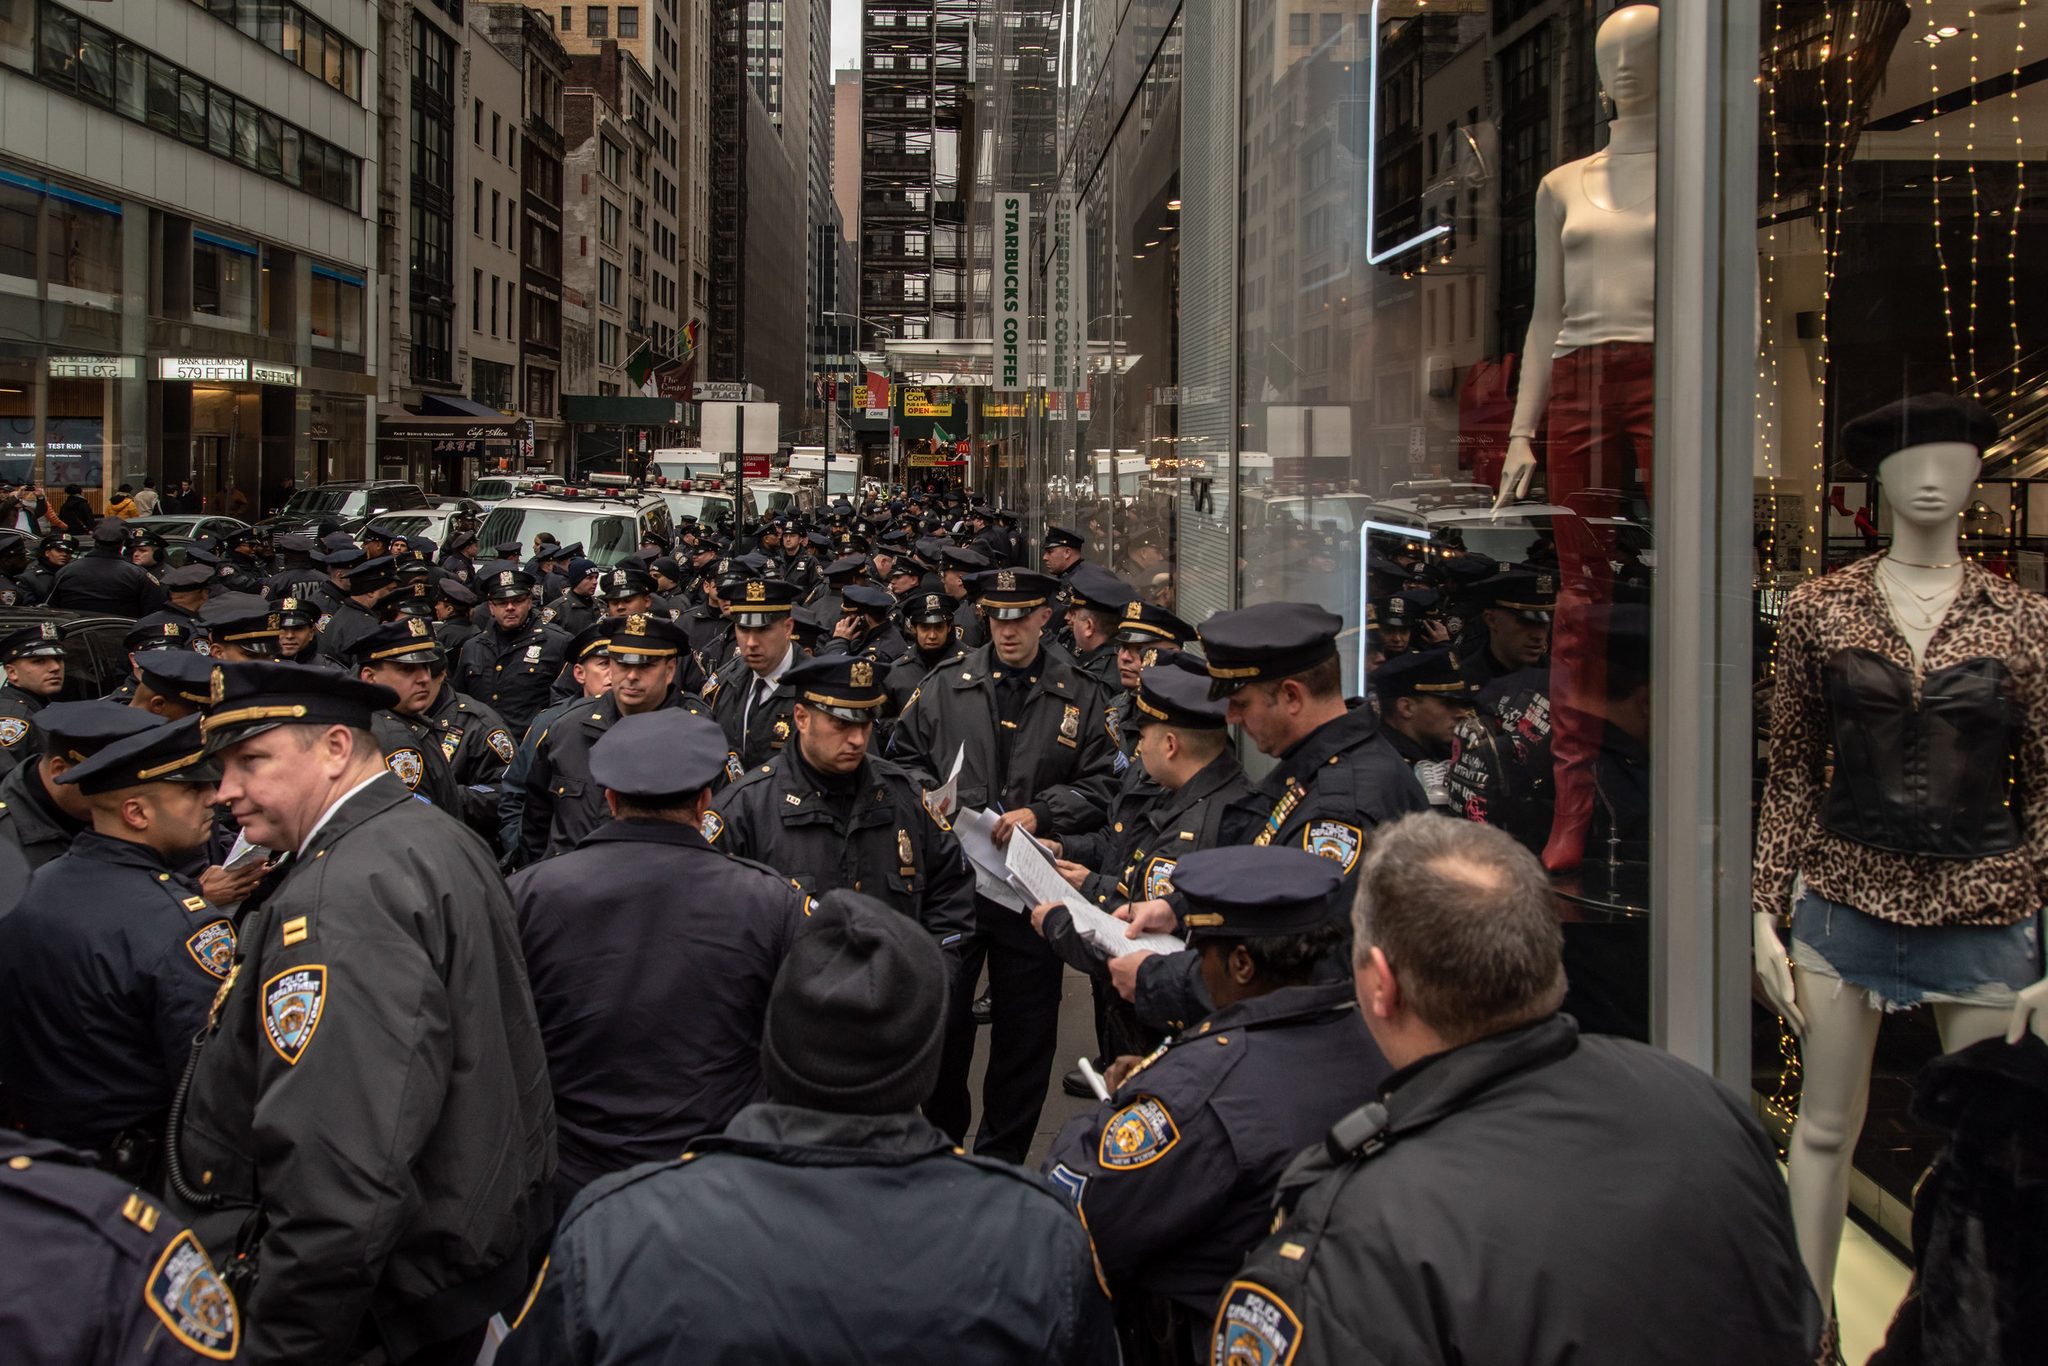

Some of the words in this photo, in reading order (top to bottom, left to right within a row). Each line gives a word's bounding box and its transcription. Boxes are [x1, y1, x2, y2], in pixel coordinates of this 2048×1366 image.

[1004, 198, 1019, 312] STARBUCKS
[178, 358, 200, 366] BANK
[227, 358, 245, 366] USA
[1003, 318, 1018, 387] COFFEE
[178, 366, 202, 379] 579
[206, 367, 244, 379] FIFTH
[663, 375, 679, 384] The
[661, 382, 687, 392] Center
[711, 391, 741, 400] PLACE
[466, 426, 484, 439] Cafe
[278, 971, 310, 987] POLICE
[268, 980, 321, 1006] DEPARTMENT
[267, 1015, 278, 1037] CITY
[275, 1035, 287, 1049] OF
[295, 1026, 311, 1049] NEW
[308, 996, 322, 1025] YORK
[1145, 1099, 1168, 1128] POLICE
[1112, 1157, 1132, 1165] NEW
[1244, 1291, 1283, 1328] POLICE
[1226, 1303, 1289, 1357] DEPARTMENT
